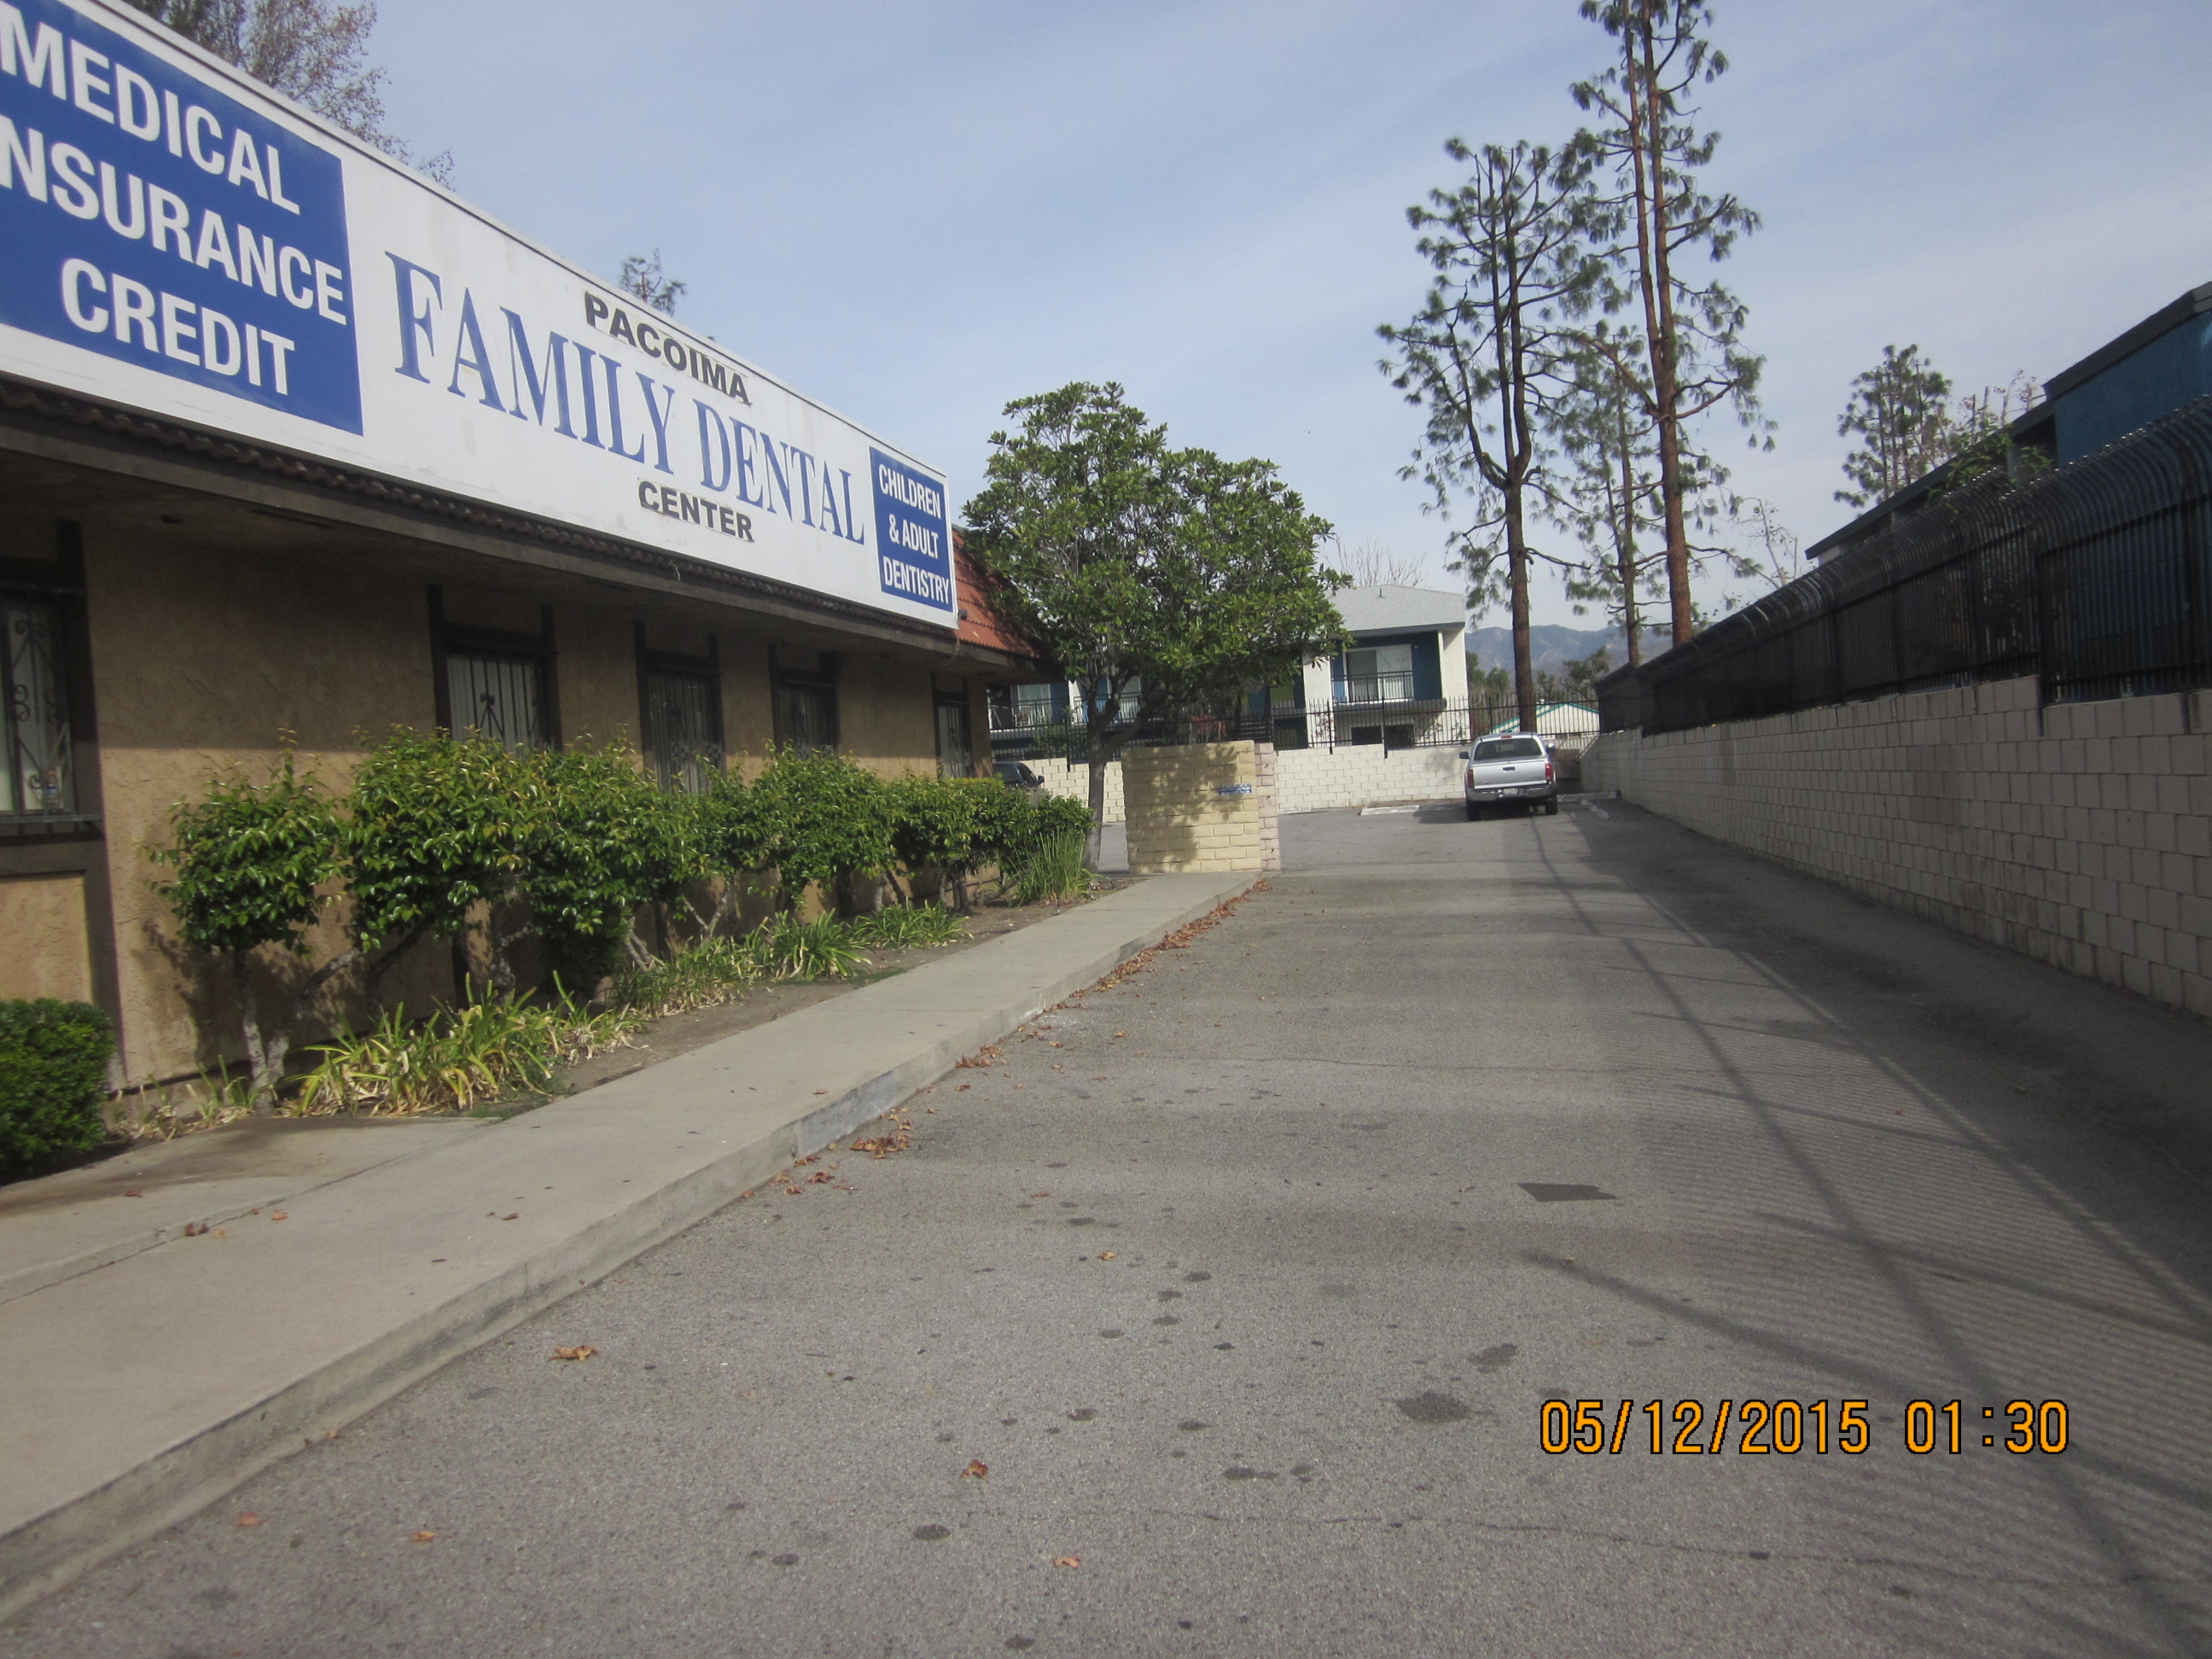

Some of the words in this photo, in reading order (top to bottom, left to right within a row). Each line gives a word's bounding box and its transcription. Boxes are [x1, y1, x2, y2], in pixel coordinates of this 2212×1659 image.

[0, 1, 300, 215] MEDICAL
[0, 114, 347, 326] NSURANCE
[61, 258, 295, 396] CREDIT
[585, 291, 752, 406] PACOIMA
[385, 251, 675, 475] FAMILY
[693, 399, 864, 545] DENTAL
[638, 480, 754, 543] CENTER
[878, 463, 941, 519] CHILDREN
[888, 513, 899, 544] &
[902, 522, 939, 559] ADULT
[882, 556, 950, 605] DENTISTRY
